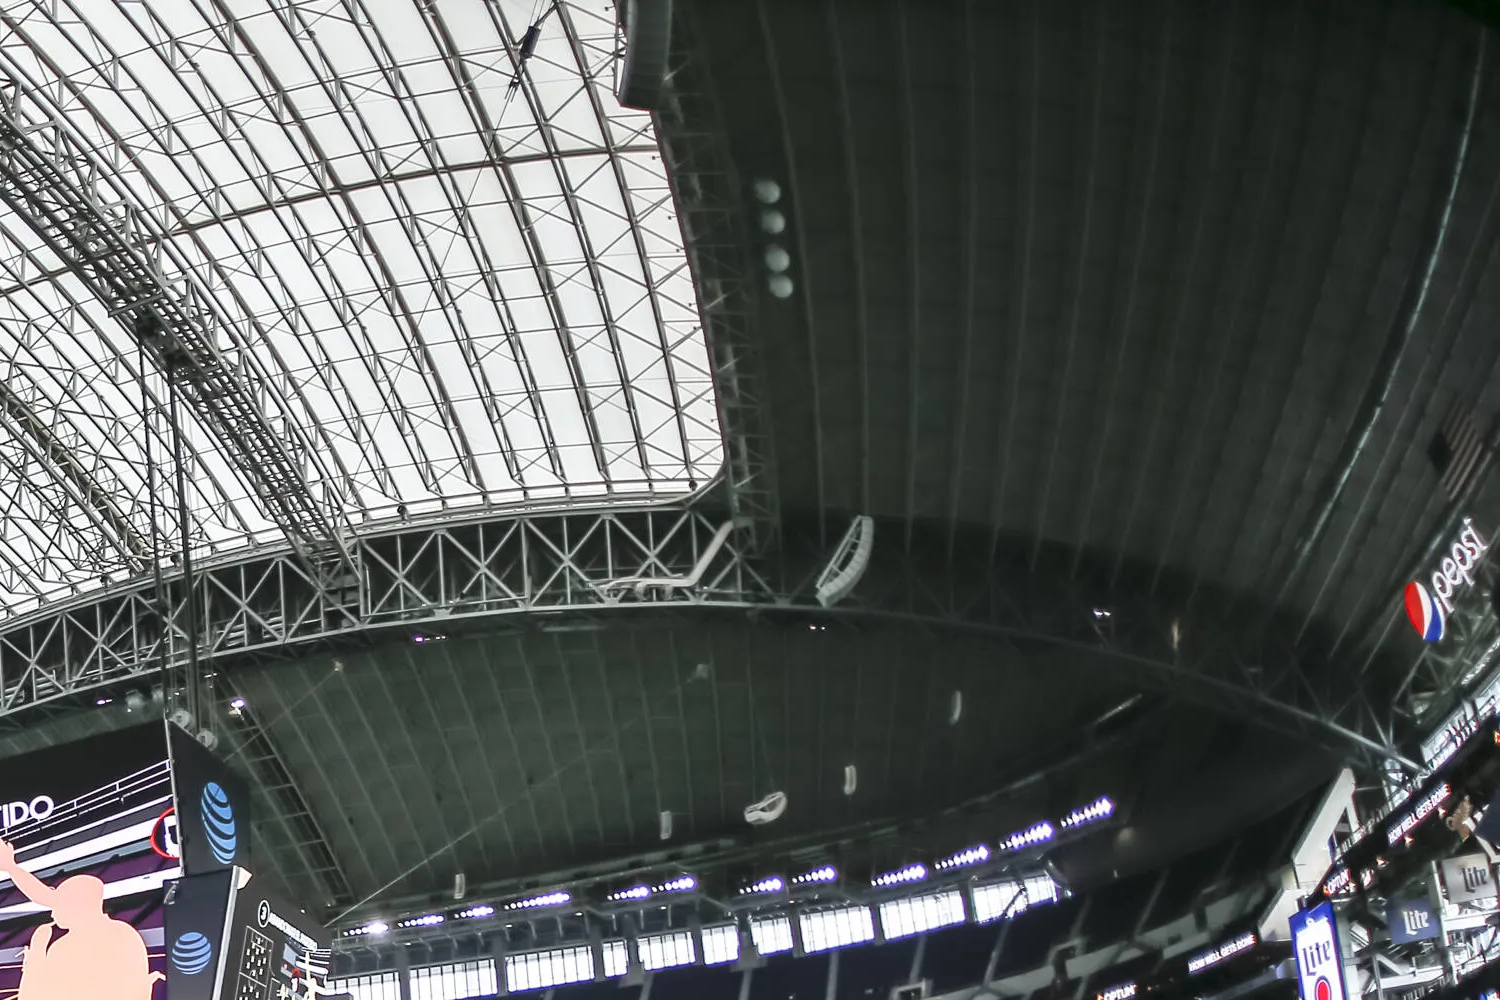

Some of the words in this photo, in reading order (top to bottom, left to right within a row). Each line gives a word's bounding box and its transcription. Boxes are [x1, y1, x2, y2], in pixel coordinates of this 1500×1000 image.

[1432, 517, 1489, 615] pepsi
[1387, 828, 1403, 845] HOW
[1402, 813, 1419, 833] WELL
[1416, 800, 1434, 820] GETS
[1431, 784, 1451, 808] DONE
[1327, 868, 1350, 893] OPTUM
[1460, 866, 1488, 894] Lite
[1402, 909, 1430, 936] Lite
[1188, 959, 1205, 974] HOW
[1204, 951, 1221, 966] WELL
[1220, 943, 1237, 957] GETS
[1236, 934, 1257, 951] DONE
[1303, 940, 1330, 976] Lite
